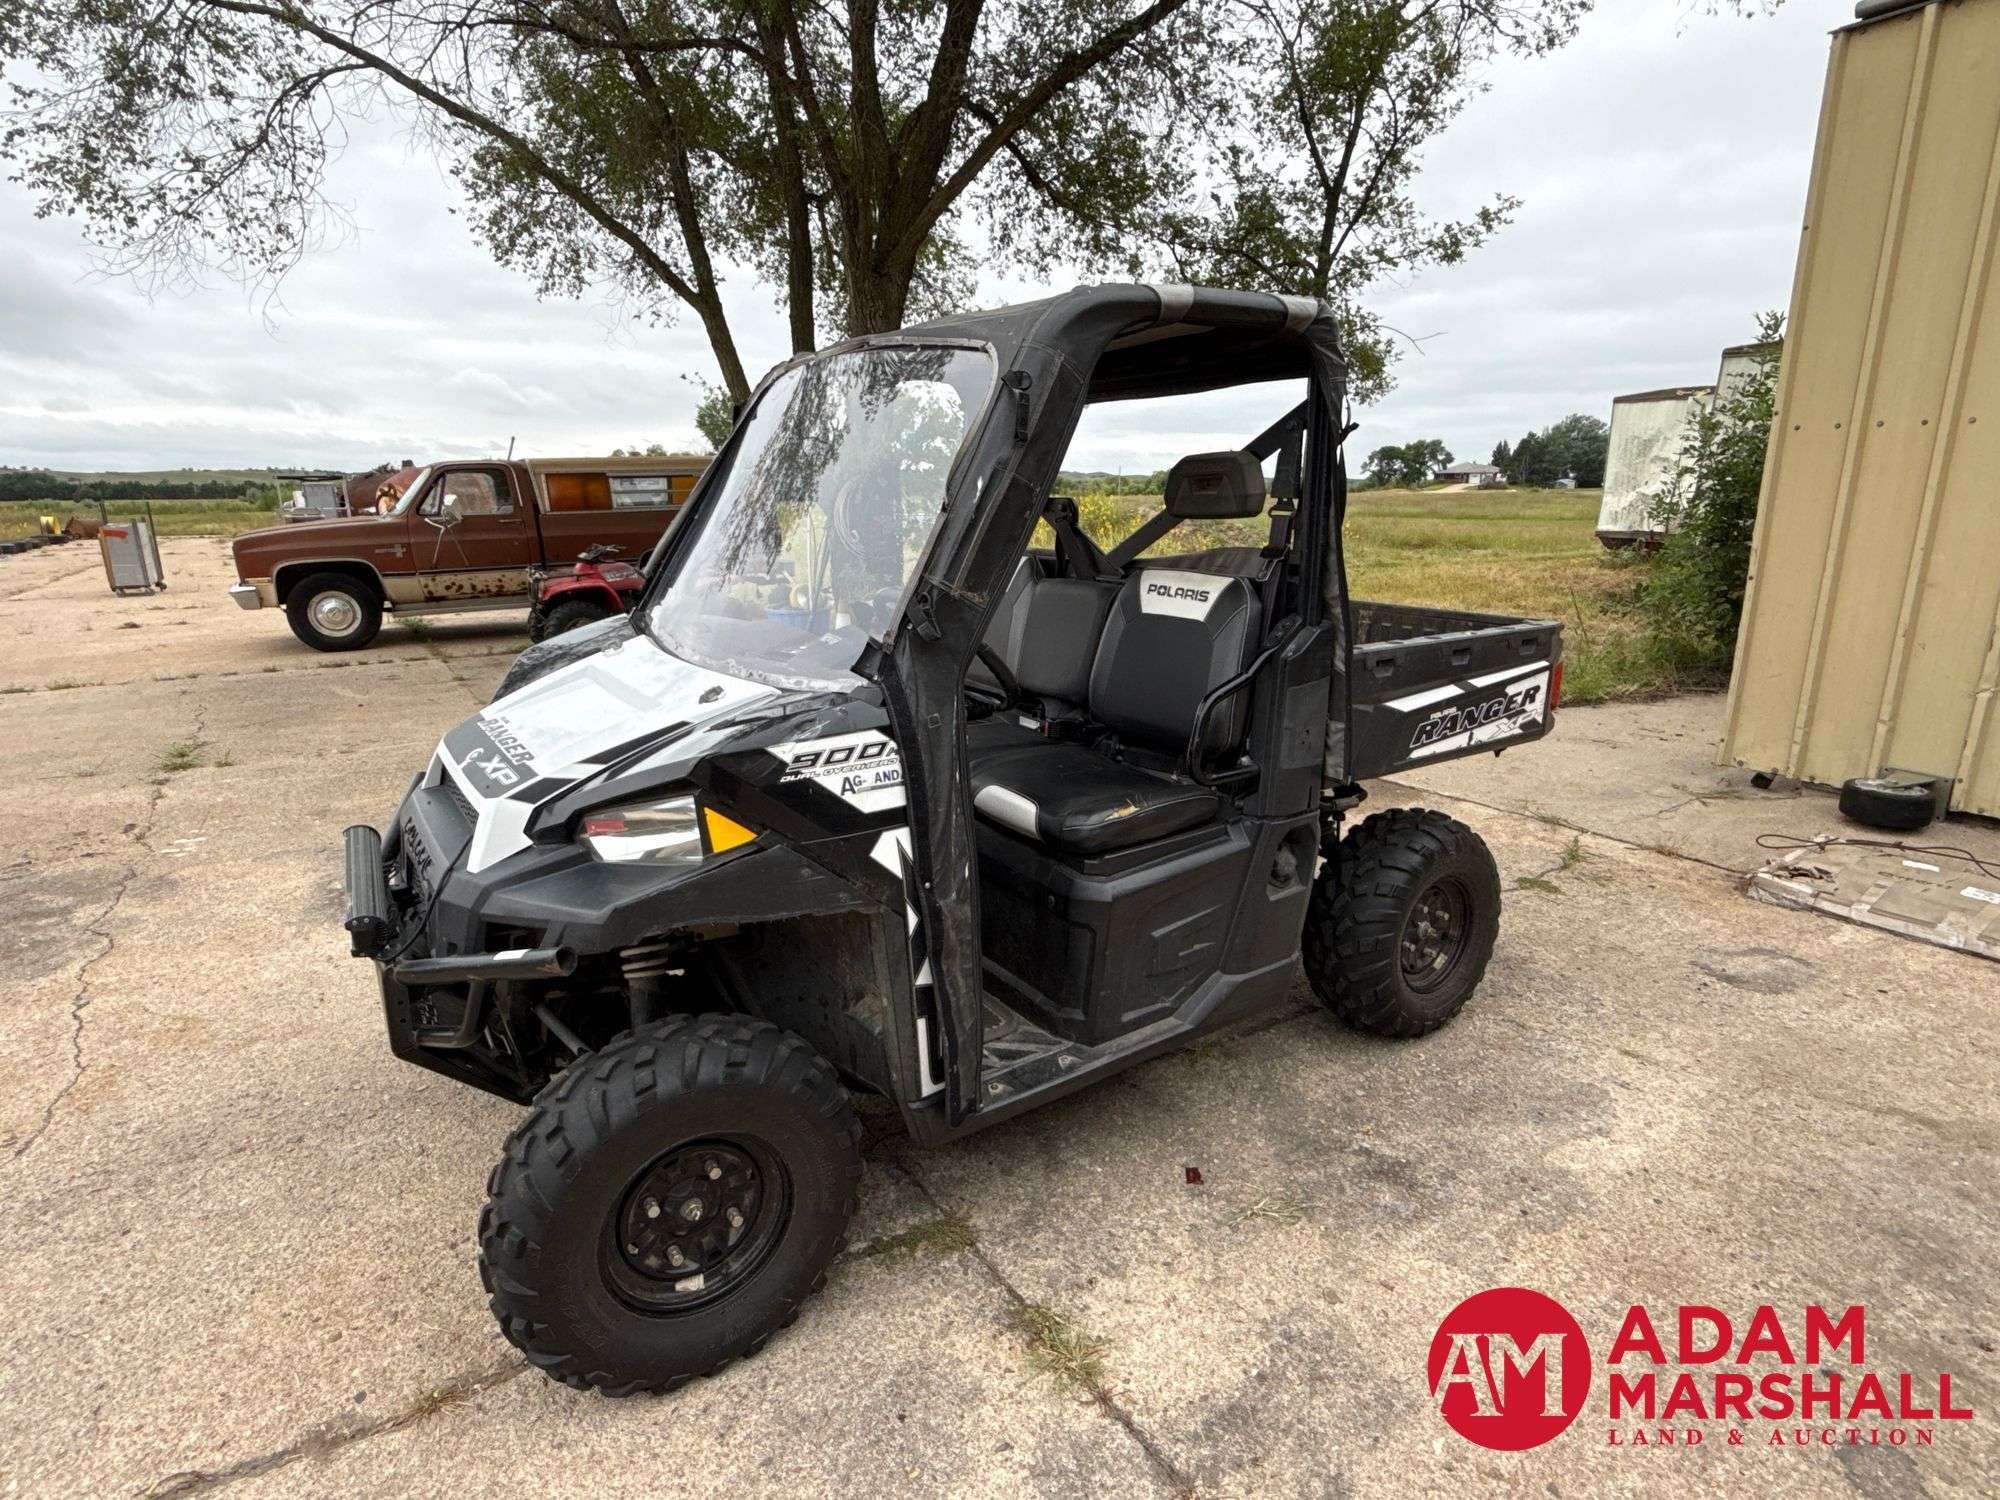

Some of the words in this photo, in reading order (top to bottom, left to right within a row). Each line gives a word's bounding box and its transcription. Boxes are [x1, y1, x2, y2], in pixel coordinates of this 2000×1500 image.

[1147, 583, 1210, 603] POLARIS
[1410, 685, 1542, 748] RANGER
[1488, 709, 1538, 741] XP
[478, 718, 535, 766] RANGER
[788, 741, 890, 772] 900
[474, 754, 520, 785] XP
[780, 771, 821, 783] DUAL
